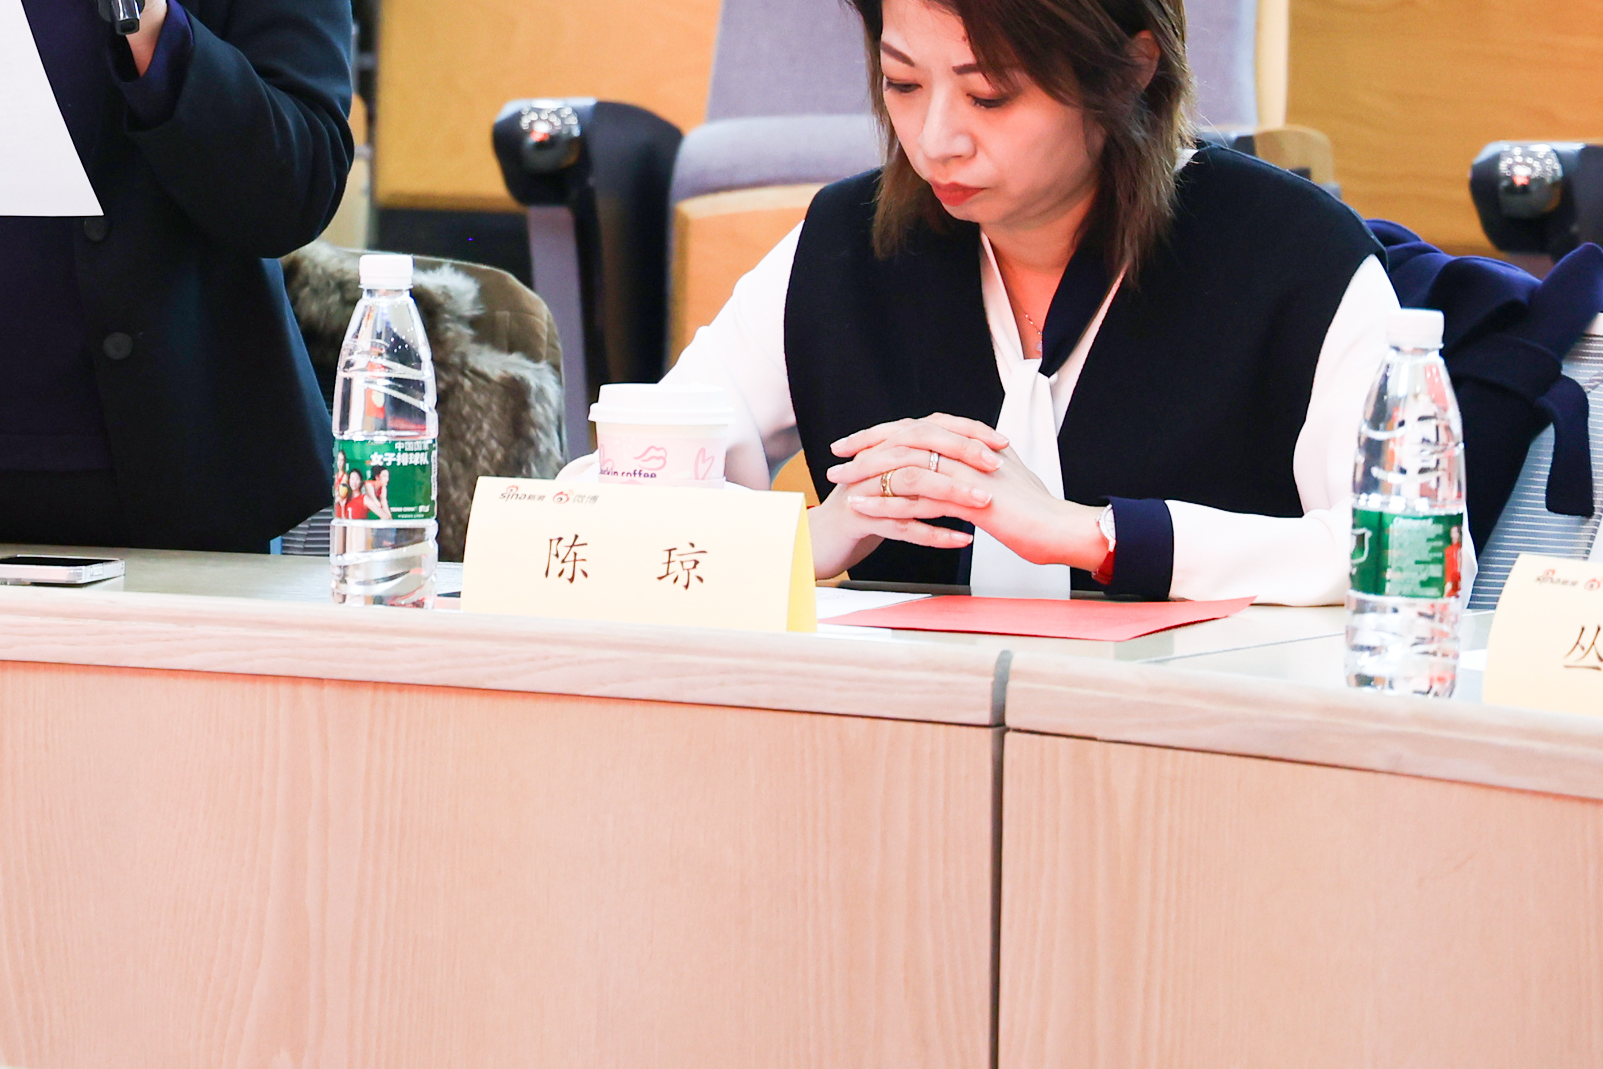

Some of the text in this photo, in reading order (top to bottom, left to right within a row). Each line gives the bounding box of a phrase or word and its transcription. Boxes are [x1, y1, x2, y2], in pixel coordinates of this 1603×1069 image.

[370, 452, 429, 466] 女子排球队
[1563, 625, 1603, 671] 丛
